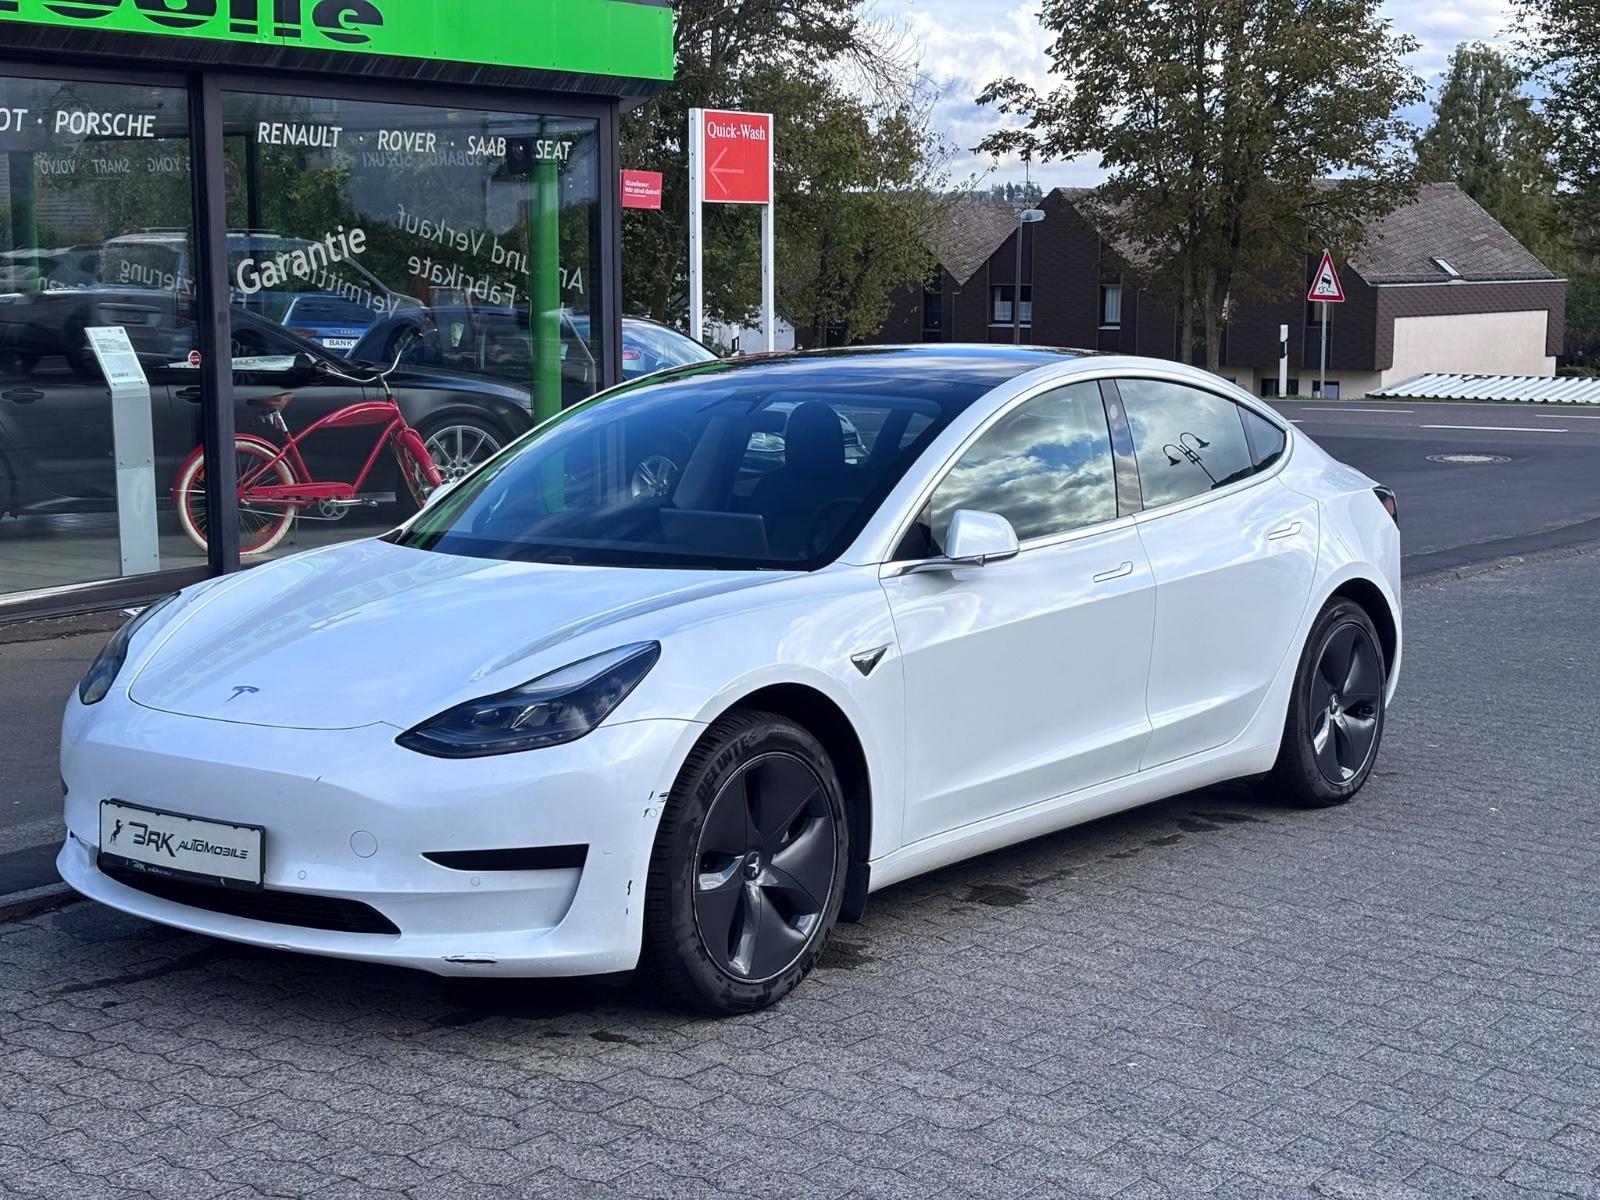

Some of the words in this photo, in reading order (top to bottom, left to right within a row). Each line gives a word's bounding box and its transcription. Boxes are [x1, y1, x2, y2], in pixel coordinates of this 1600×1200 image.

[55, 110, 156, 138] PORSCHE
[257, 121, 343, 148] RENAULT
[377, 129, 437, 153] ROVER
[467, 135, 507, 157] SAAB
[535, 139, 573, 161] SEAT
[707, 121, 766, 140] Quick-Wash
[236, 225, 367, 294] Garantie
